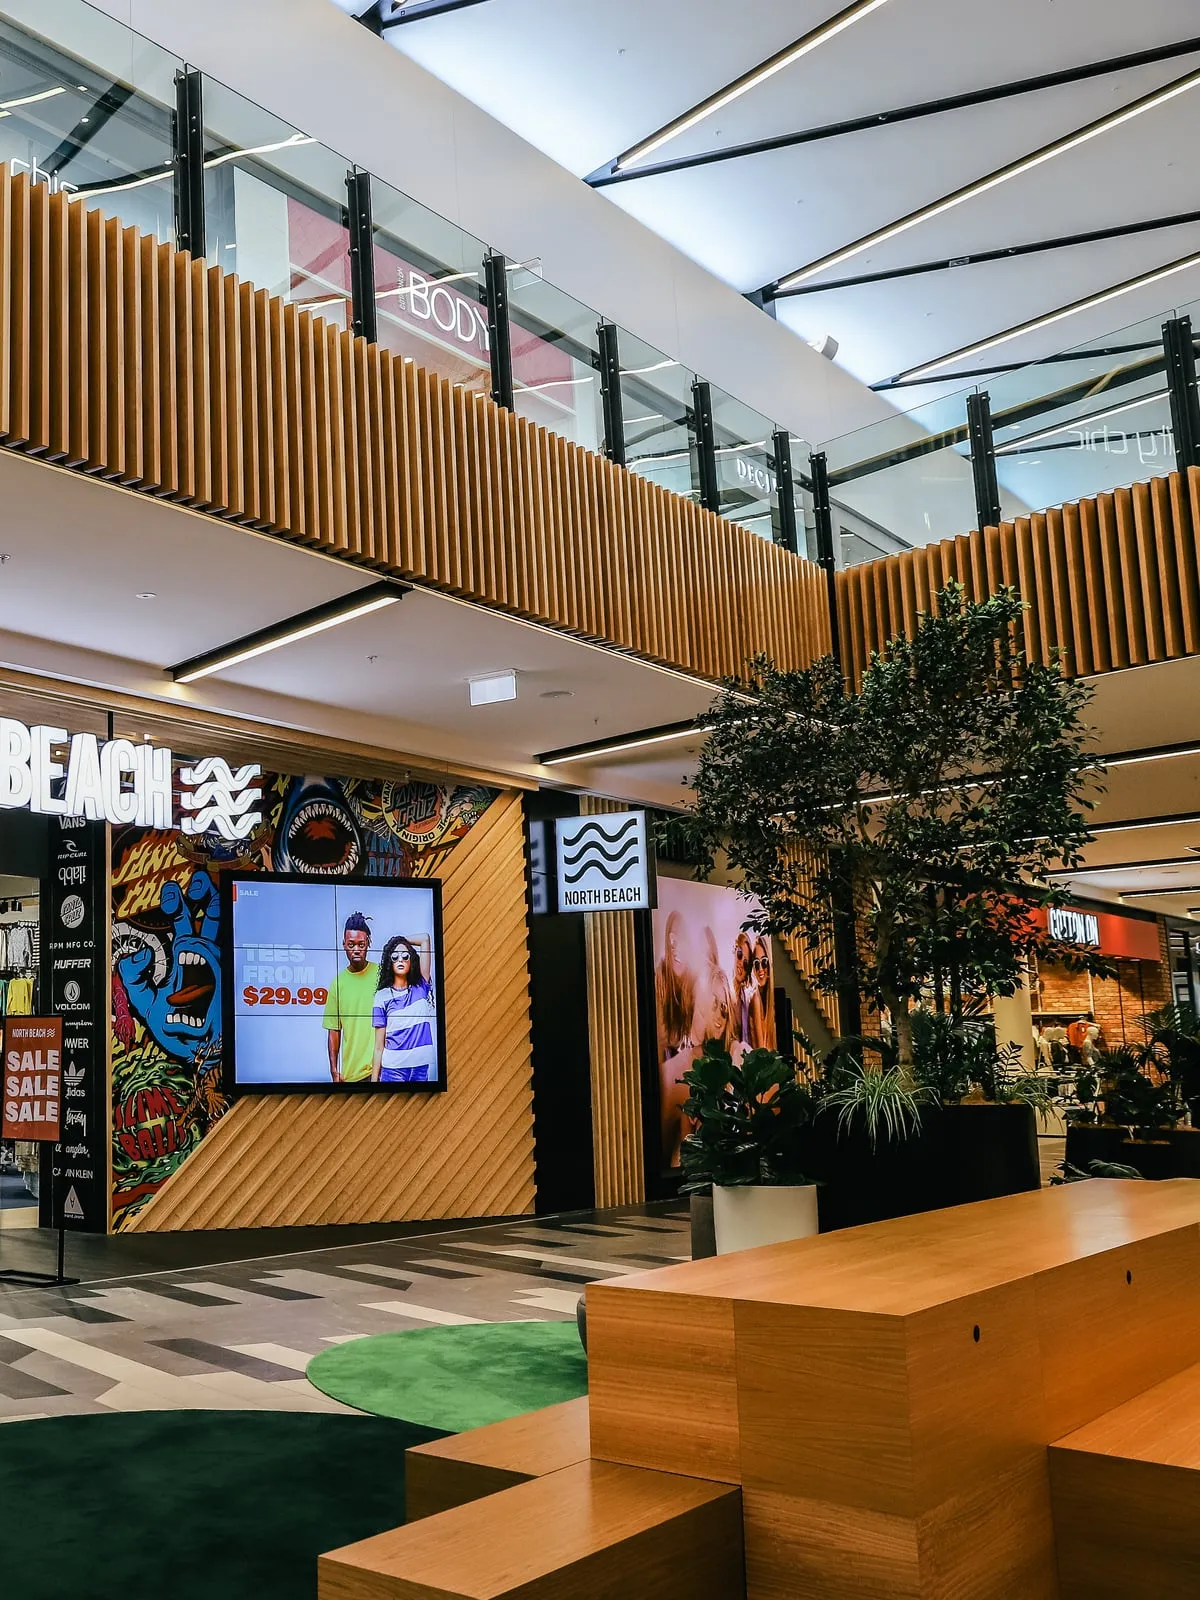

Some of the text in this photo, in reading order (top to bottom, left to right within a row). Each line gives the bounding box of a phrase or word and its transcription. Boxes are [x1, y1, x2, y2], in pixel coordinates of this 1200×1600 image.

[409, 271, 490, 351] BODY
[58, 815, 86, 830] VANS
[239, 889, 259, 897] SALE
[564, 887, 641, 906] NORTH BEACH
[1050, 907, 1100, 946] COTTON ON
[66, 941, 81, 949] MFG
[243, 943, 306, 963] TEES
[53, 958, 92, 970] HUFFER
[243, 965, 316, 985] FROM
[243, 986, 328, 1006] $29.99
[54, 1003, 91, 1011] VOLCOM
[12, 1028, 46, 1038] NORTH BEACH
[7, 1049, 59, 1071] SALE
[6, 1075, 59, 1097] SALE
[5, 1101, 58, 1122] SALE
[114, 1086, 184, 1131] SLIME
